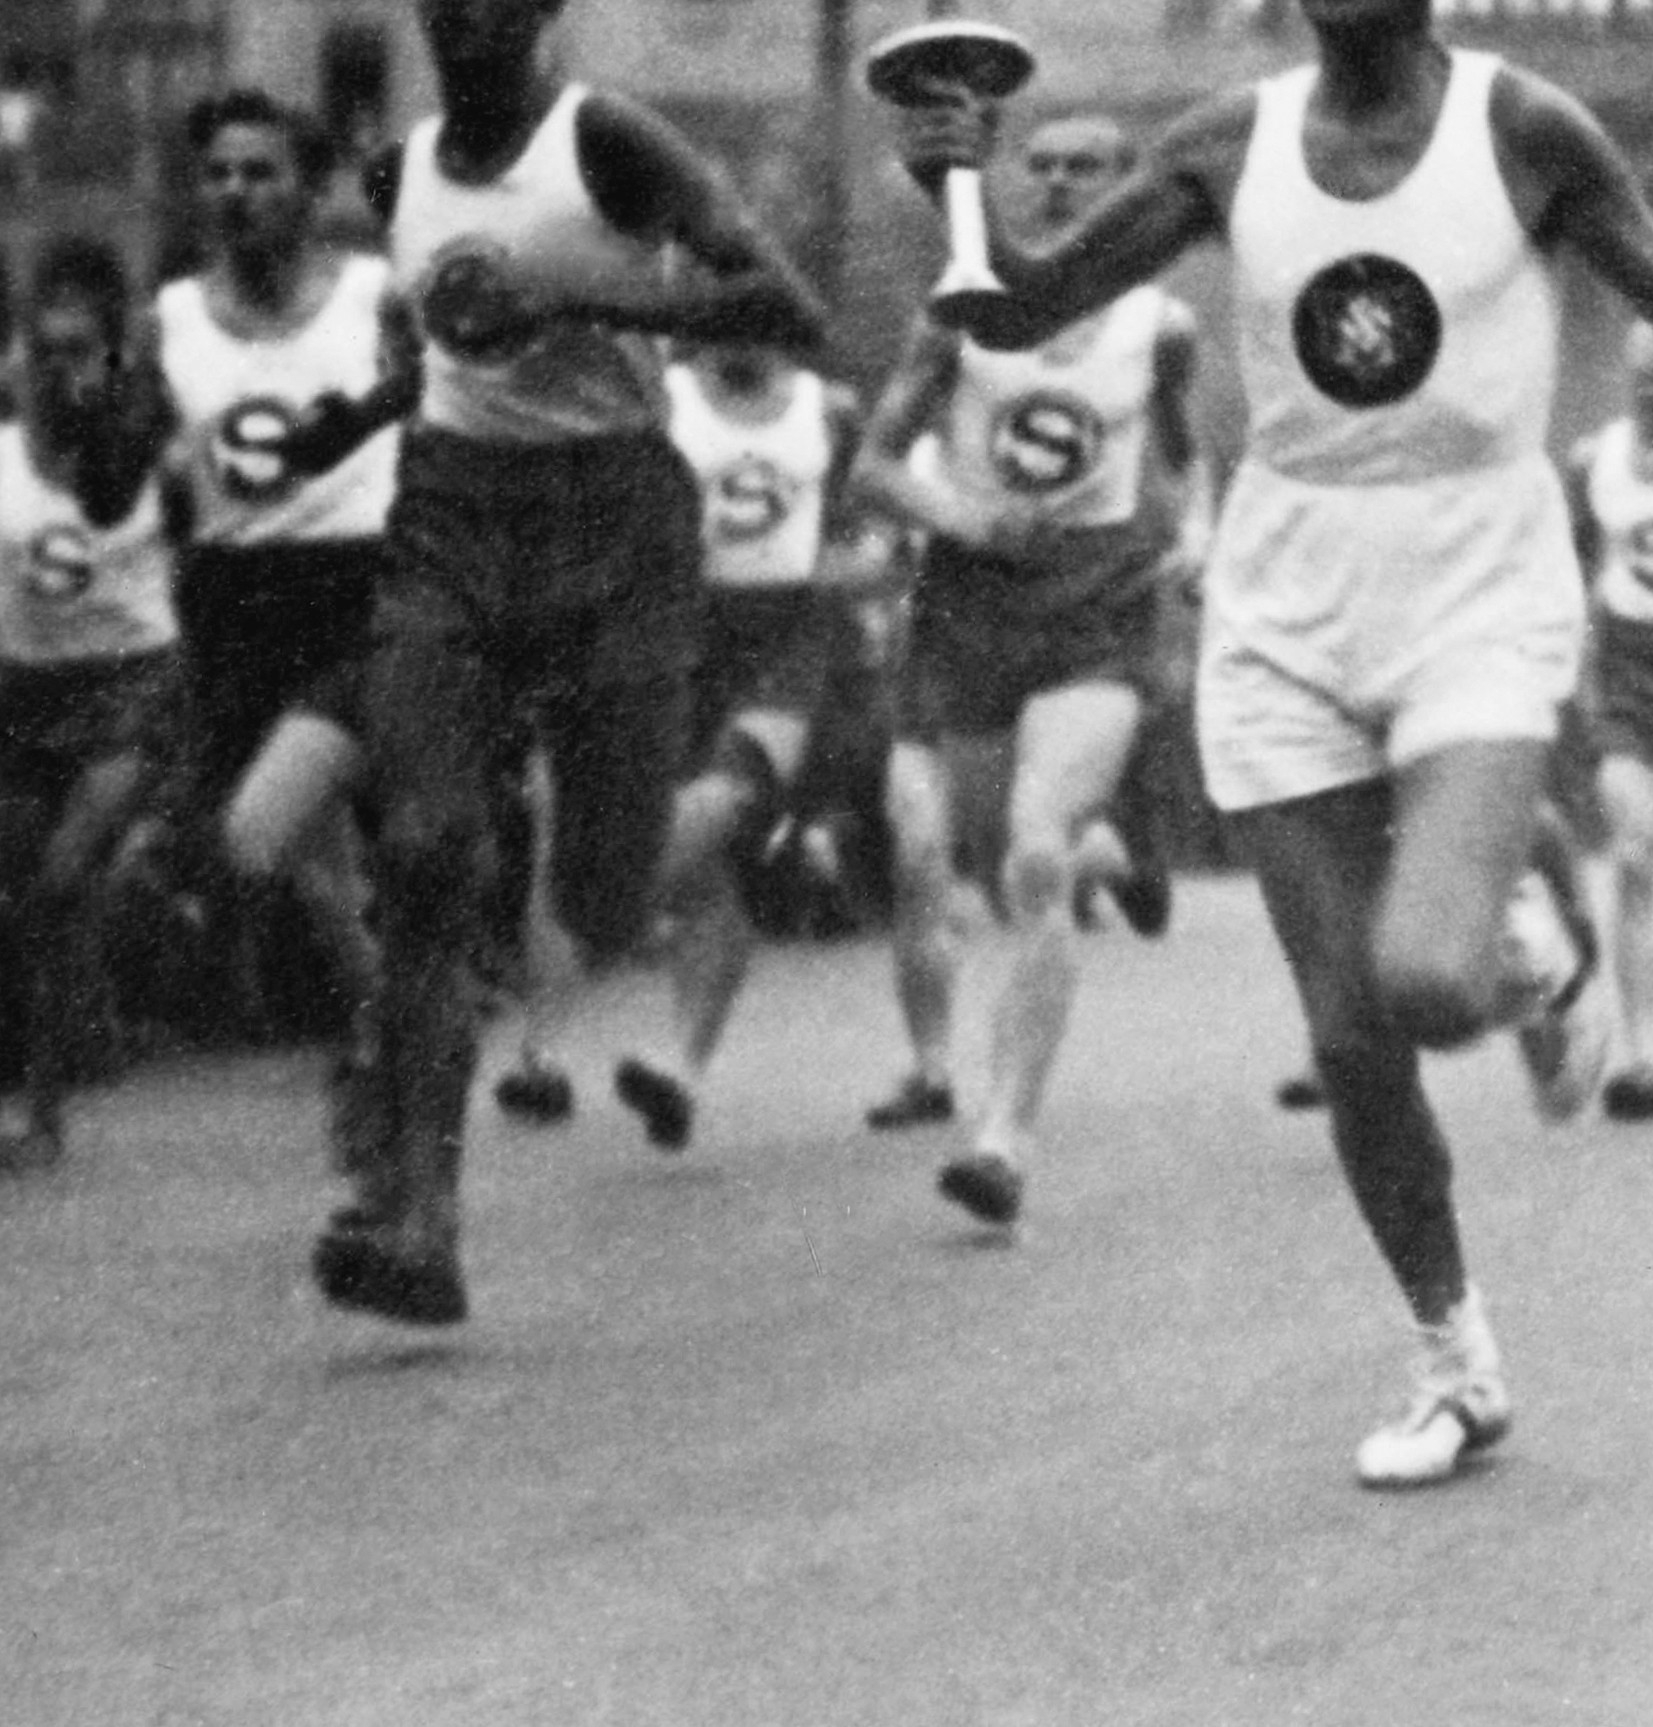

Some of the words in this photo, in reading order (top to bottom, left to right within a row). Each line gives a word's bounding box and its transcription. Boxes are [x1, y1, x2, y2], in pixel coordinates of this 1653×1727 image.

[220, 398, 294, 504] S
[1003, 393, 1085, 493] S
[719, 462, 784, 539] S
[28, 526, 91, 598] S
